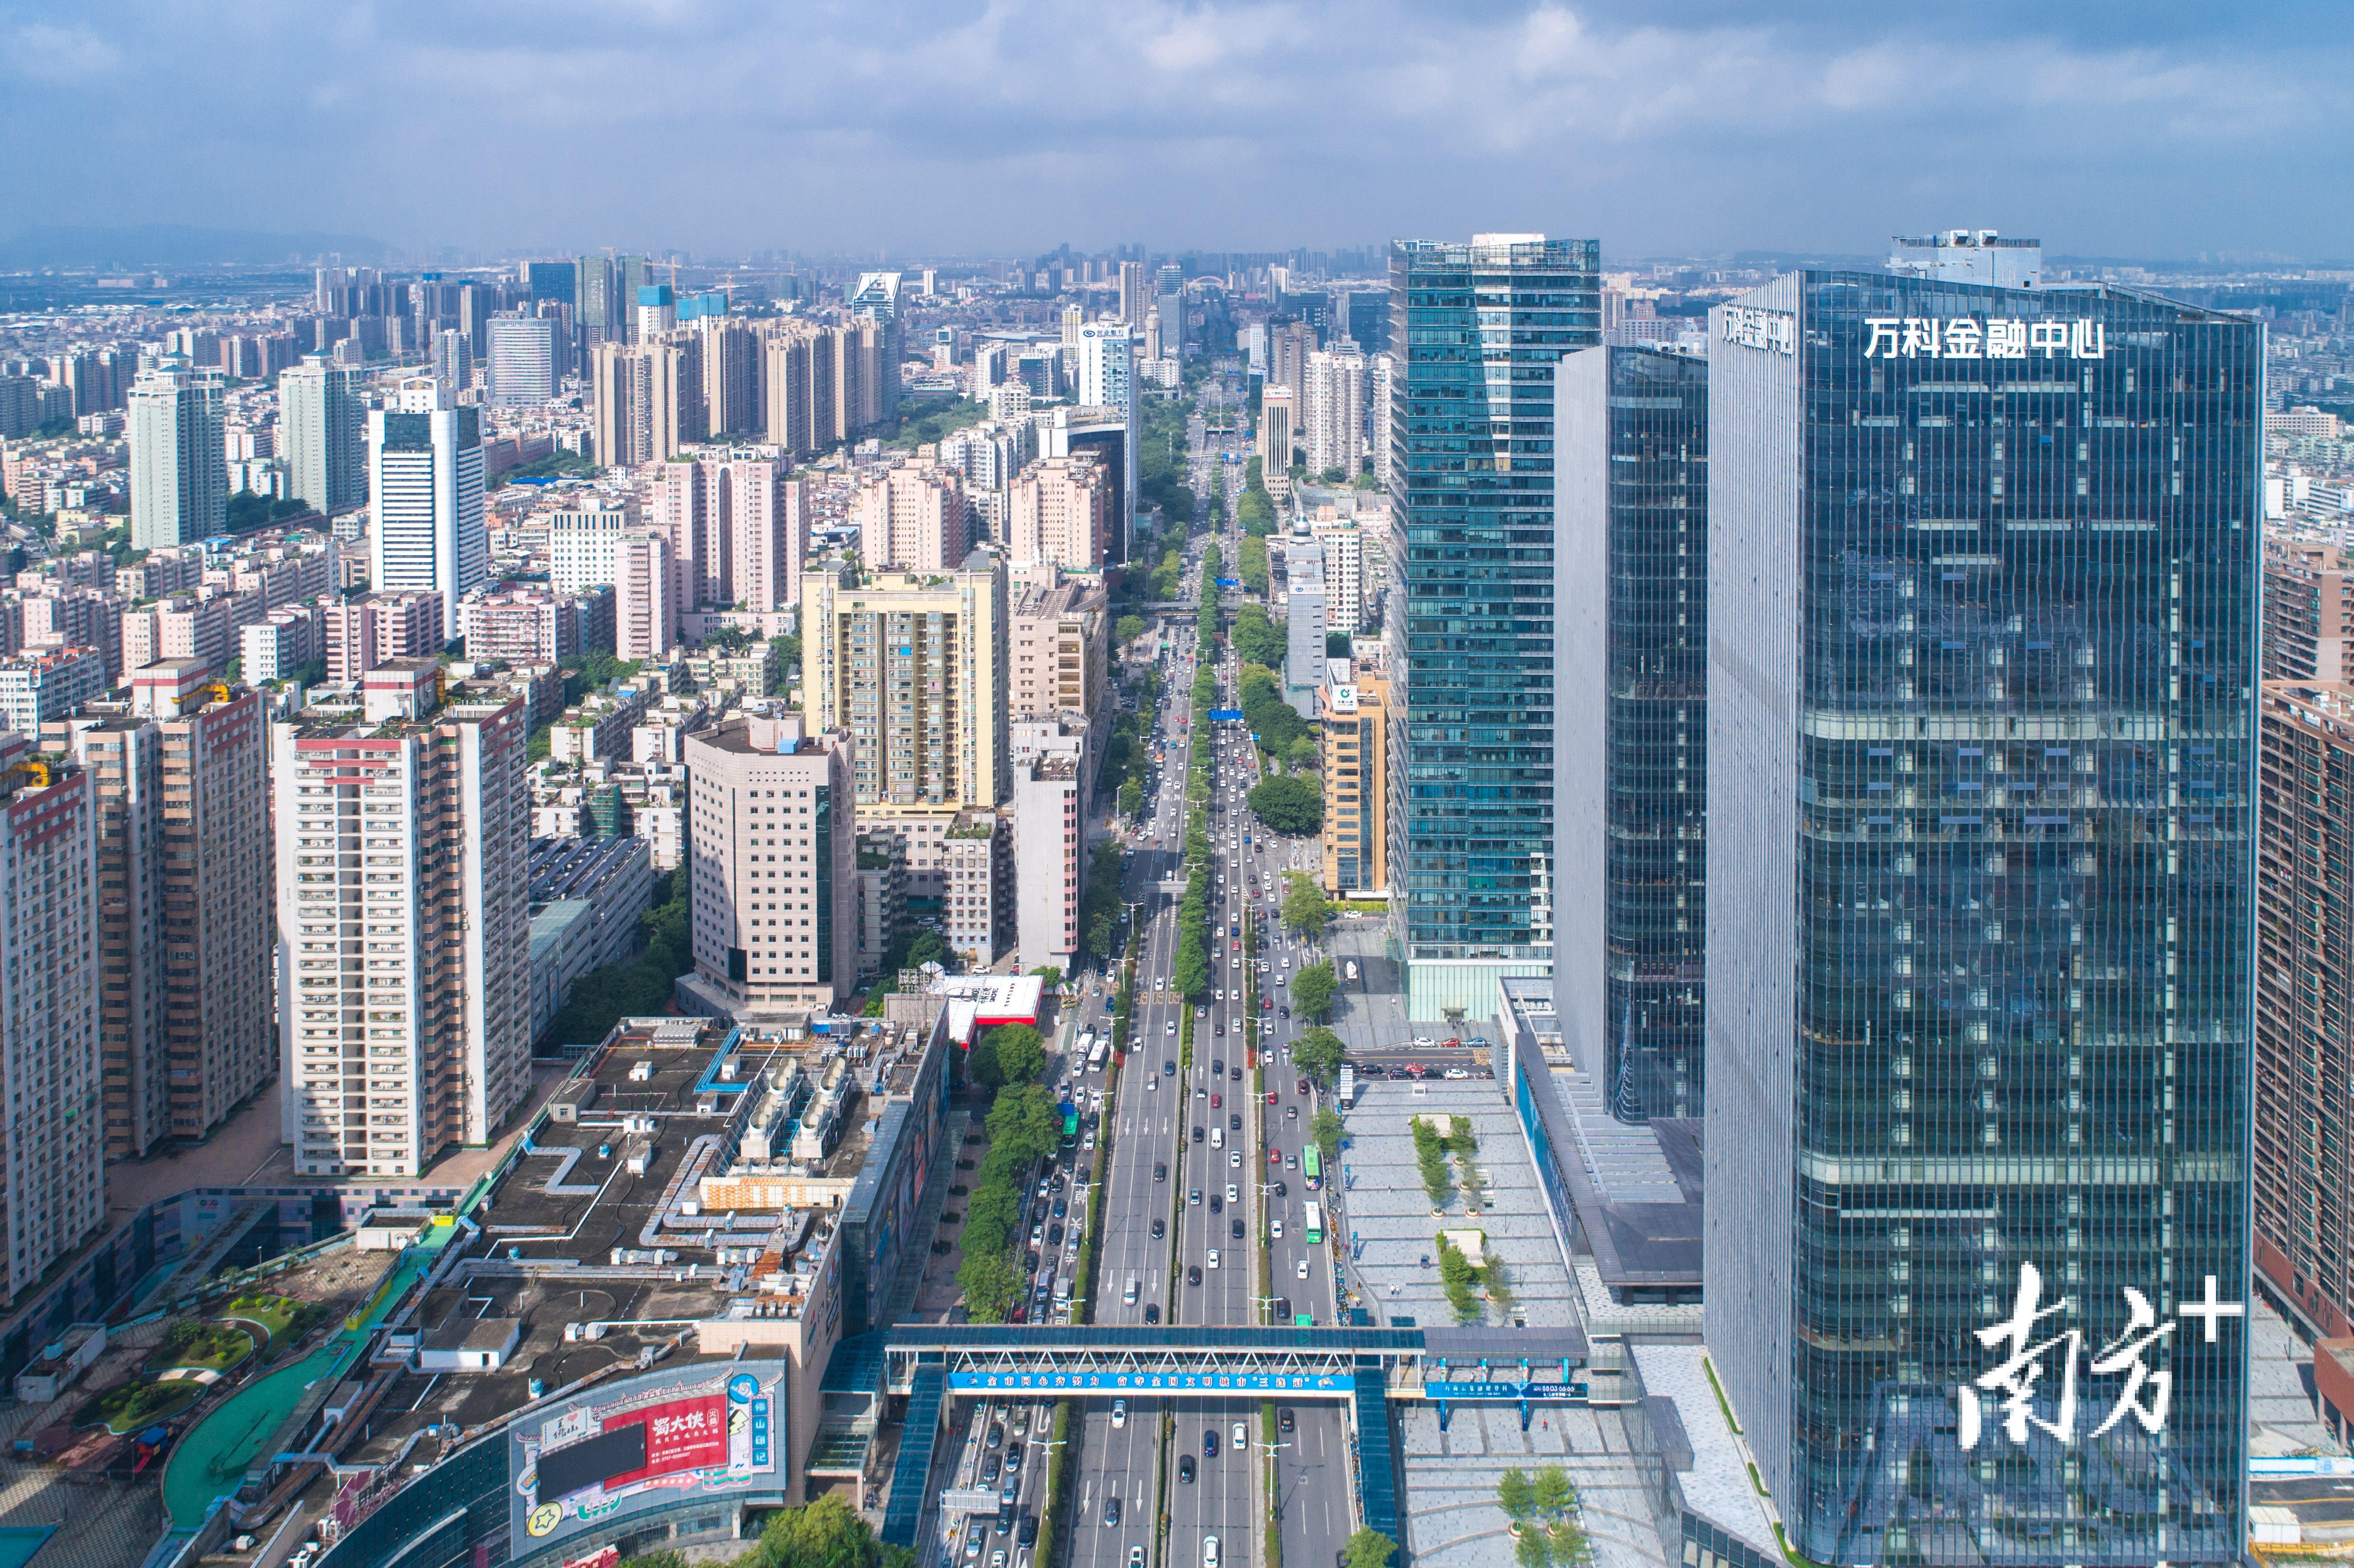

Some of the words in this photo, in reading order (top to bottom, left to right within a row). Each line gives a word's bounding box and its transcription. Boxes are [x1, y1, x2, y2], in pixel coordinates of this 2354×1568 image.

[1722, 306, 1795, 355] 万科金融中心
[1863, 318, 2104, 359] 万科金融中心
[987, 1375, 1100, 1386] 全市同心齐努力
[554, 1424, 579, 1439] 佛山
[652, 1410, 706, 1436] 蜀大侠
[755, 1401, 766, 1462] 佛山印记
